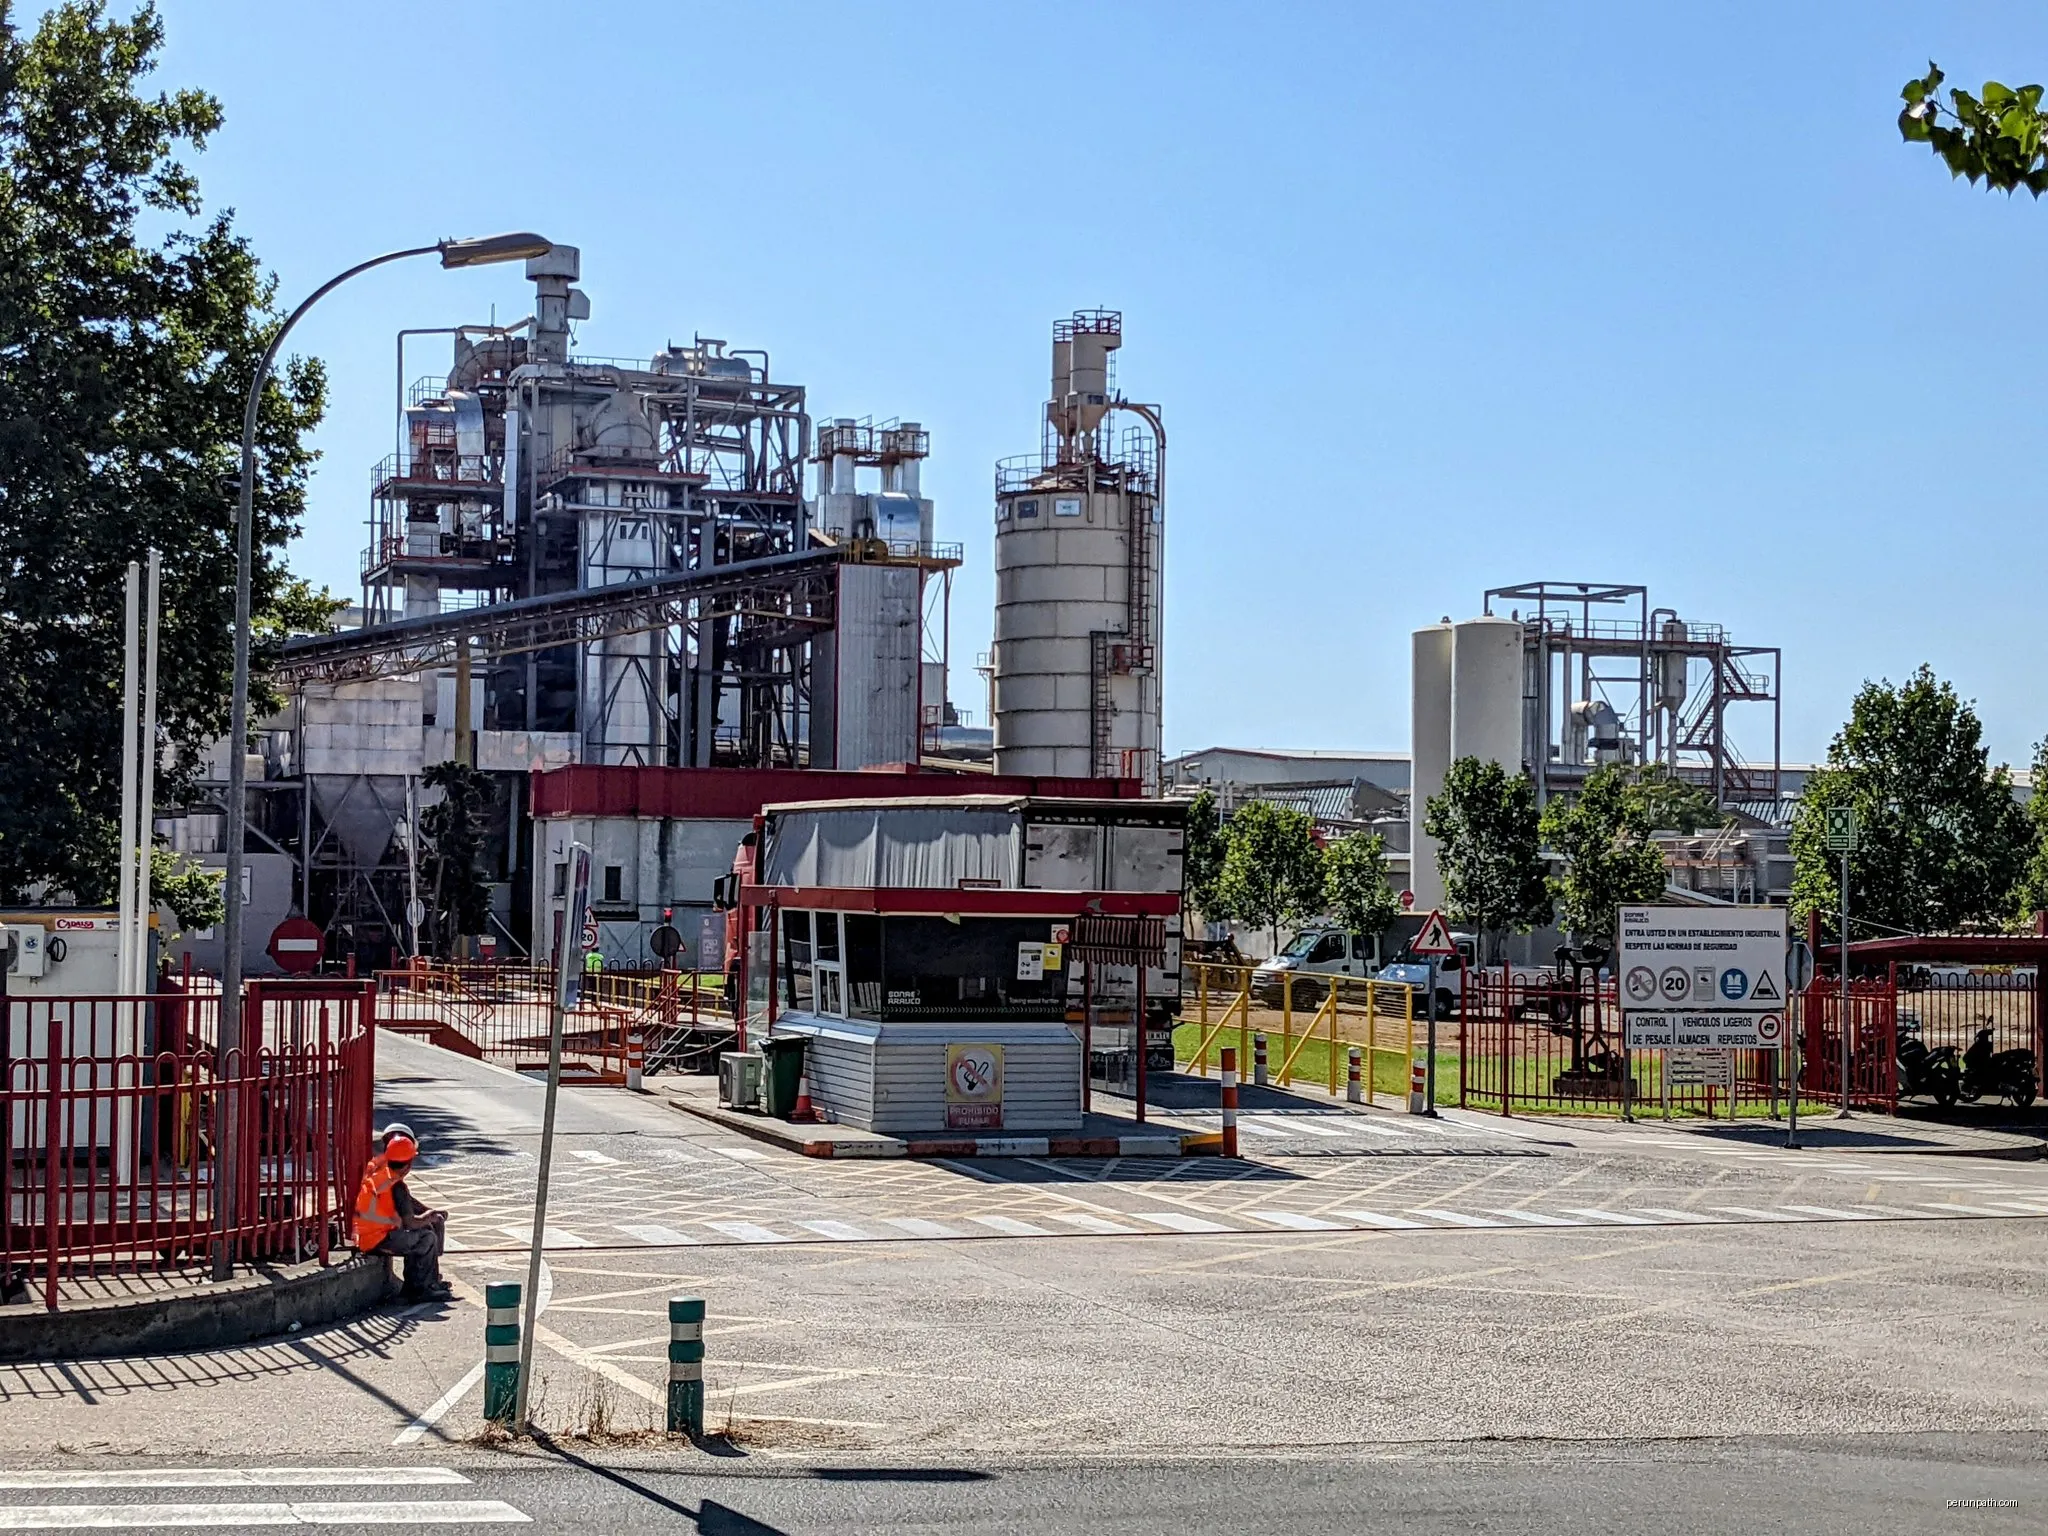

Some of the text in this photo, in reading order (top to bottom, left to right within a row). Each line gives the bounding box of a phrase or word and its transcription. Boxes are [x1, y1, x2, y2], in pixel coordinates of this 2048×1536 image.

[581, 933, 593, 942] 20
[1625, 929, 1781, 938] ENTRA USTED EN UN ESTABLECIMIENTO INDUSTRIAL
[1625, 942, 1651, 950] RESPETE
[1652, 942, 1664, 950] LAS
[1693, 943, 1702, 951] DE
[1703, 943, 1738, 951] SEGURIDAD
[1665, 977, 1685, 991] 20
[1635, 1016, 1668, 1027] CONTROL
[1682, 1017, 1752, 1027] VEHICULOS LIGEROS
[1632, 1034, 1672, 1045] DE PESAJE
[1677, 1034, 1758, 1045] ALMACEN REPUESTOS
